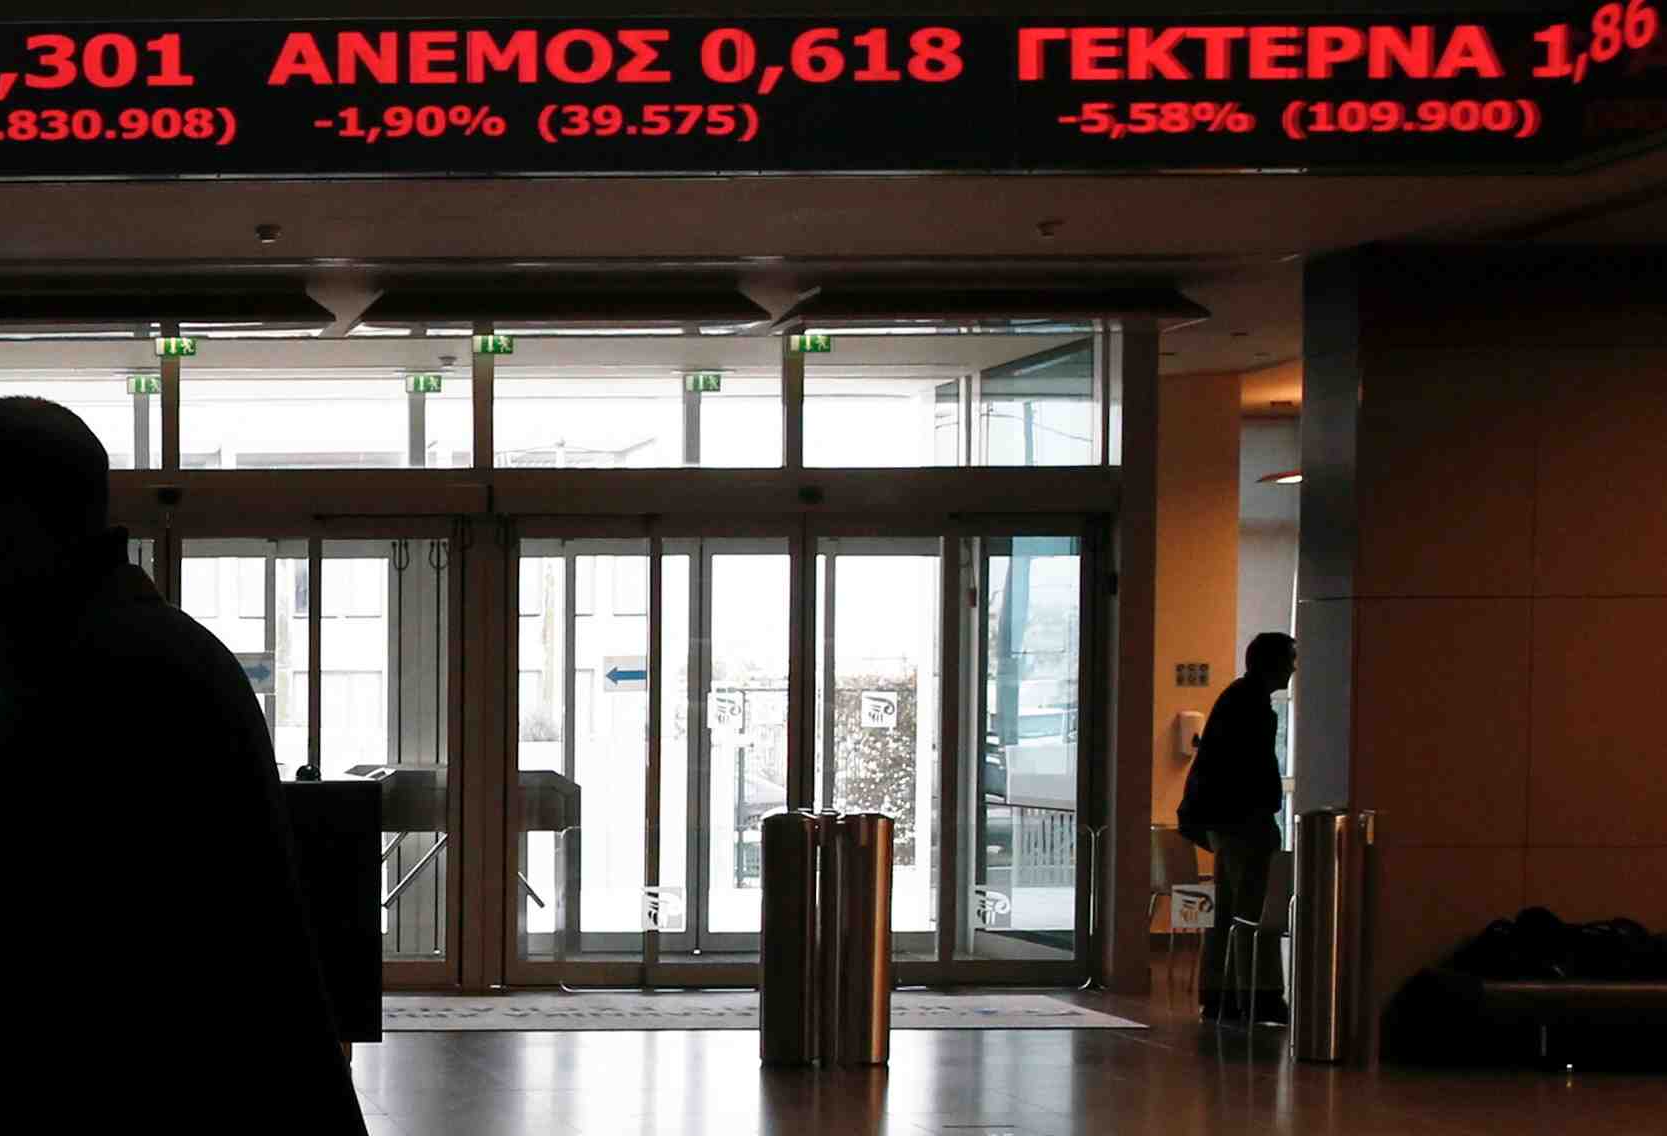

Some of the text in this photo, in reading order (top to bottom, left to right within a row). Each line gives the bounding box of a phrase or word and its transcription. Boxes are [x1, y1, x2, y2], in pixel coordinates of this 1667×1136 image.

[268, 27, 672, 86] ΑΝΕΜΟΣ
[700, 25, 965, 96] 0,618
[1017, 23, 1503, 82] ΓΕΚΤΕΡΝΑ
[1533, 0, 1658, 83] 1,86
[314, 104, 508, 144] -1,90%
[537, 102, 760, 144] (39.575)
[1057, 100, 1256, 140] -5,58%
[1281, 98, 1541, 141] (109.900)
